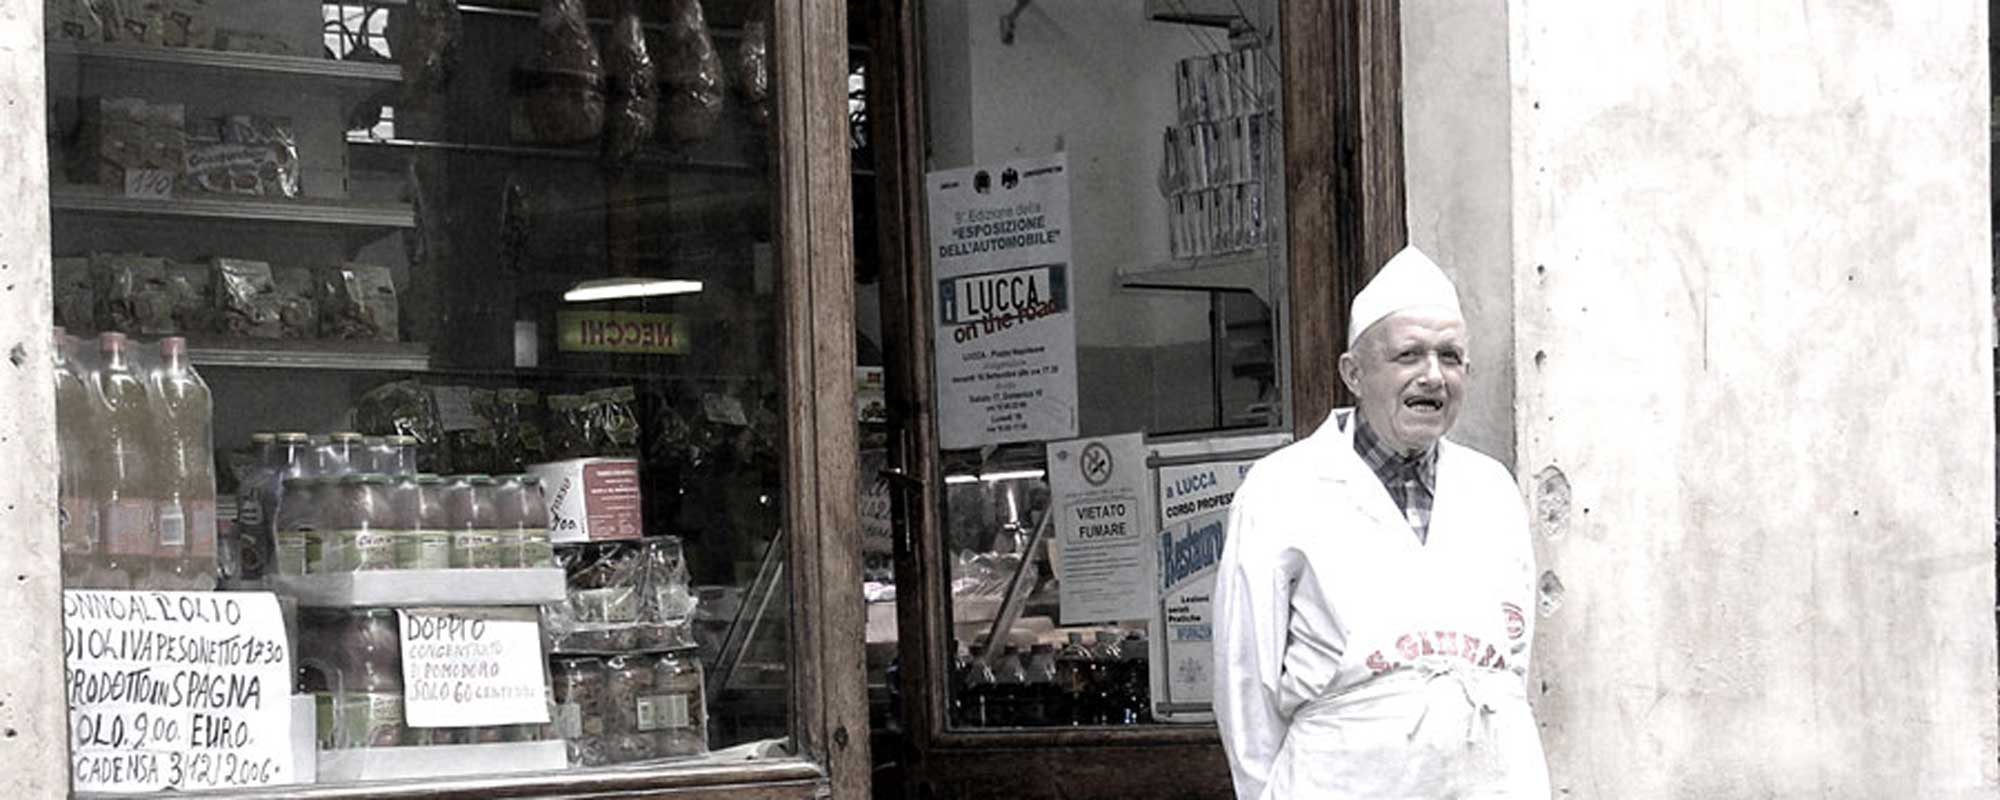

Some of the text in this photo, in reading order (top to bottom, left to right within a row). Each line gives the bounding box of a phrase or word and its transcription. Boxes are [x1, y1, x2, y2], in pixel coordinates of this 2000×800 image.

[966, 275, 1039, 315] LUCCA
[954, 321, 978, 343] on
[983, 311, 1013, 335] the
[1175, 471, 1217, 496] LUCCA
[1076, 503, 1125, 519] VIETATO
[1166, 501, 1196, 518] CORSO
[1079, 522, 1126, 538] FUMARE
[407, 614, 486, 641] DOPPIO
[155, 632, 199, 663] PESO
[199, 634, 241, 666] NETTO
[169, 670, 262, 710] SPAGNA
[409, 680, 450, 701] SOLO
[453, 681, 472, 703] 60
[74, 752, 159, 783] CADENSA
